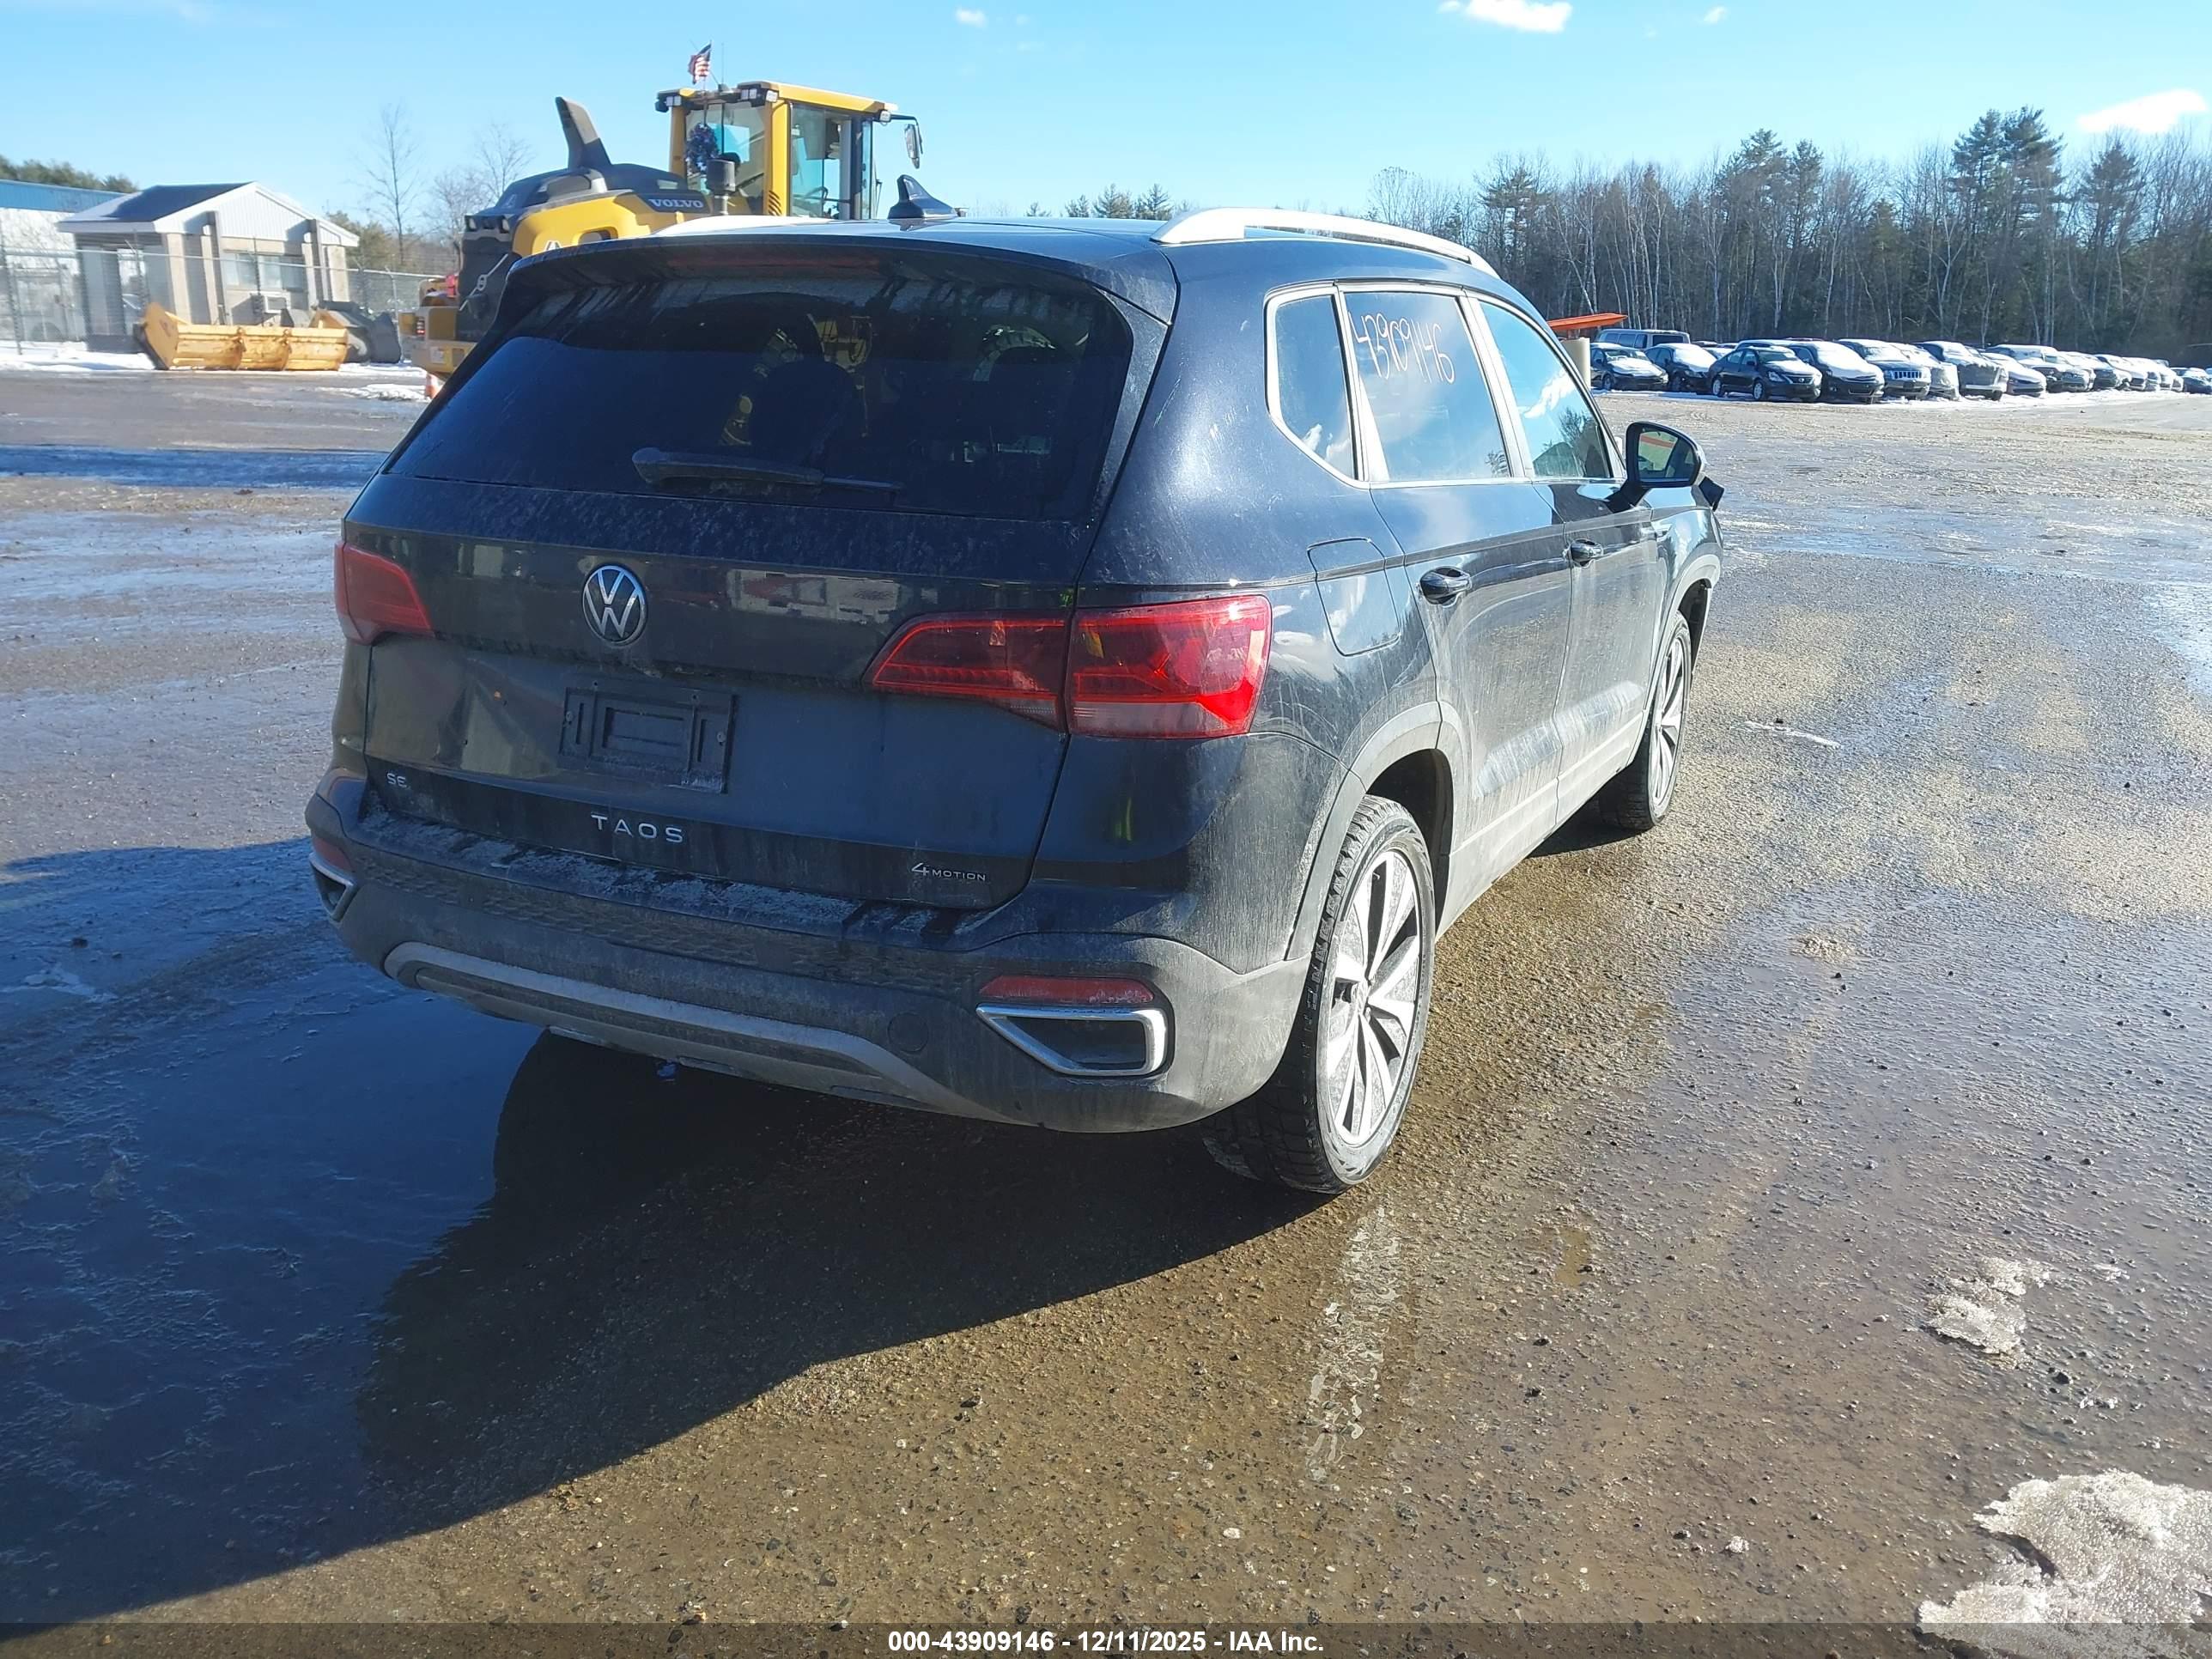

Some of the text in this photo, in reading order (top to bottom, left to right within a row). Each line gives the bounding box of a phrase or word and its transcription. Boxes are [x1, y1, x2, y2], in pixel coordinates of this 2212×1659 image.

[648, 198, 704, 208] VOLVO
[1347, 312, 1455, 384] 43909146
[584, 565, 645, 643] VW
[386, 773, 407, 788] SE
[591, 814, 684, 843] TAOS
